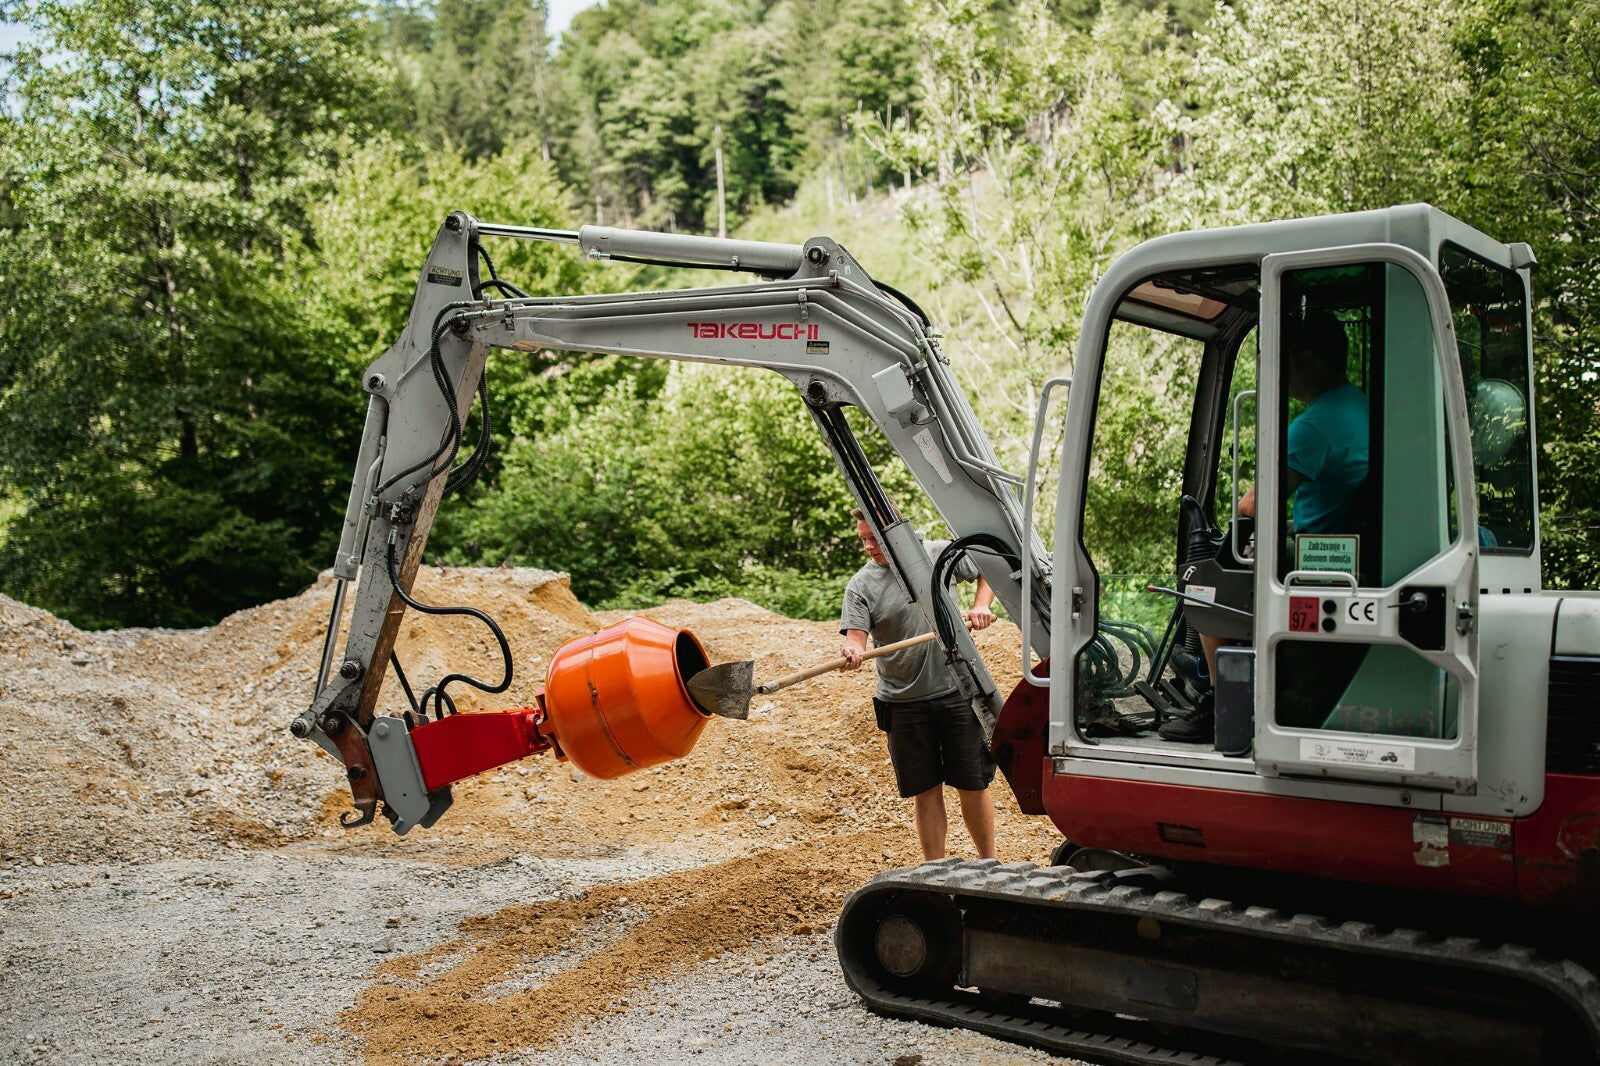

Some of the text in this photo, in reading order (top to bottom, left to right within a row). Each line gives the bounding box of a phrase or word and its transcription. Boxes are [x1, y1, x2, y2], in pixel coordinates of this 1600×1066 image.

[431, 267, 461, 277] ACHTUNG
[1303, 553, 1328, 562] delovnem
[1349, 602, 1374, 621] CE
[1292, 612, 1307, 629] 97
[1456, 820, 1507, 834] ACHTUNG
